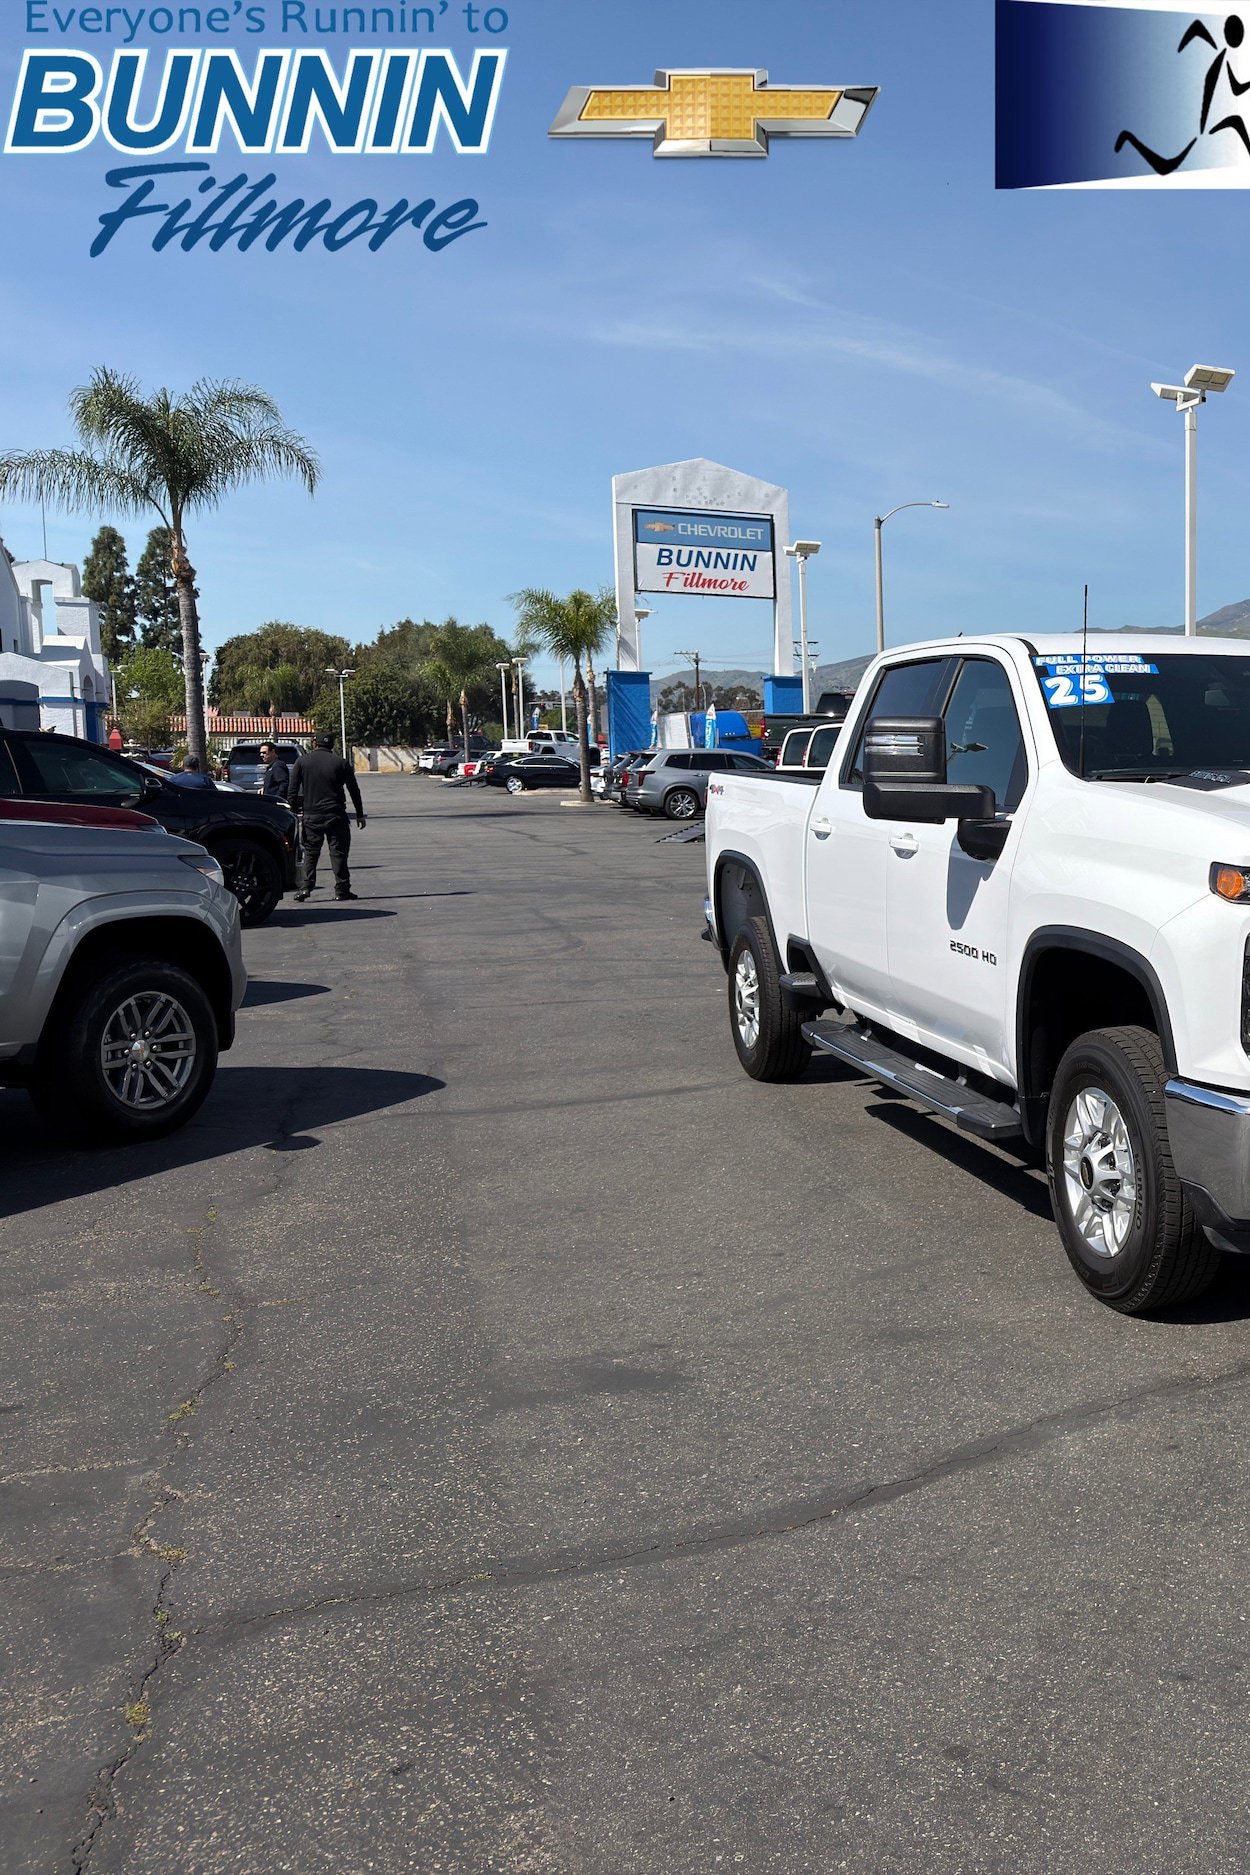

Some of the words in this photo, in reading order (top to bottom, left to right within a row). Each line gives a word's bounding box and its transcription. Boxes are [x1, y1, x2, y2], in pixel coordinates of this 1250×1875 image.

[677, 522, 764, 541] CHEVROLET
[656, 547, 758, 572] BUNNIN
[662, 571, 750, 592] Fillmore
[1035, 655, 1079, 666] FULL
[1081, 654, 1142, 664] POWER
[1056, 663, 1105, 675] EXTRA
[1105, 663, 1151, 674] CLEAN
[1044, 674, 1109, 706] 25
[949, 939, 979, 960] 2500
[981, 950, 998, 967] HD
